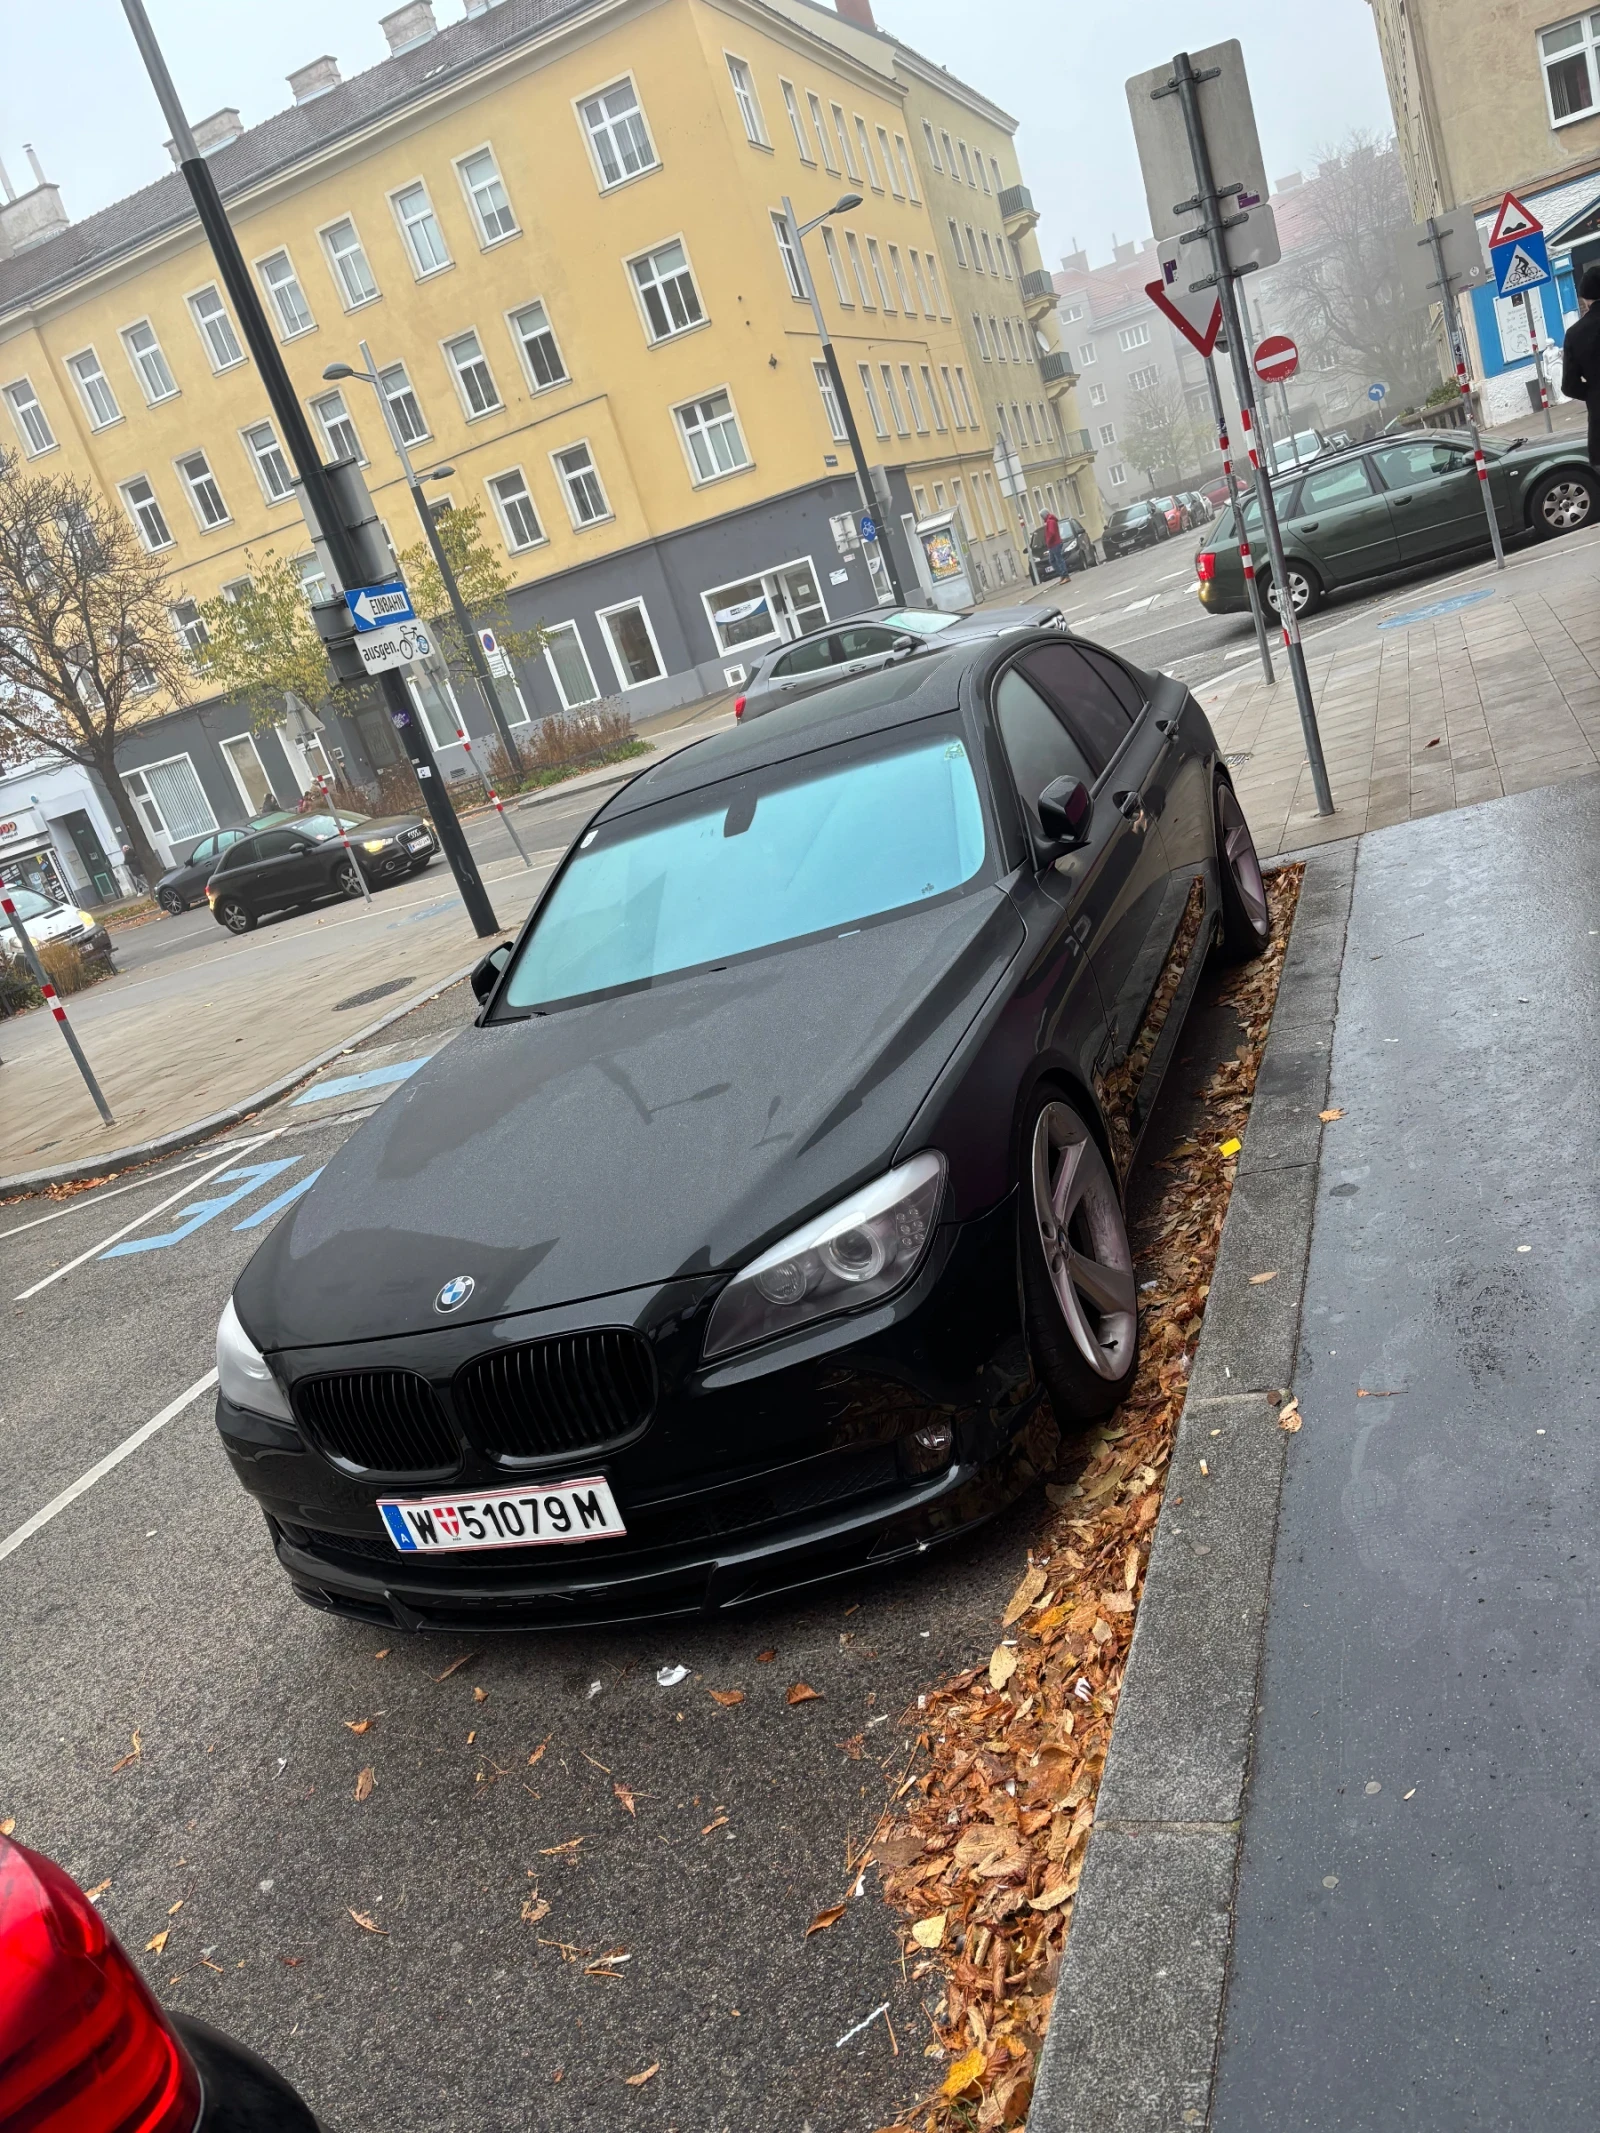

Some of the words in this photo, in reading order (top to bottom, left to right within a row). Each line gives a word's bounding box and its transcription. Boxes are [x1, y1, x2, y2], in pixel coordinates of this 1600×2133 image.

[369, 594, 406, 616] EINBAHN
[362, 641, 400, 662] ausgen.
[407, 1510, 438, 1544] W
[401, 1533, 410, 1543] A
